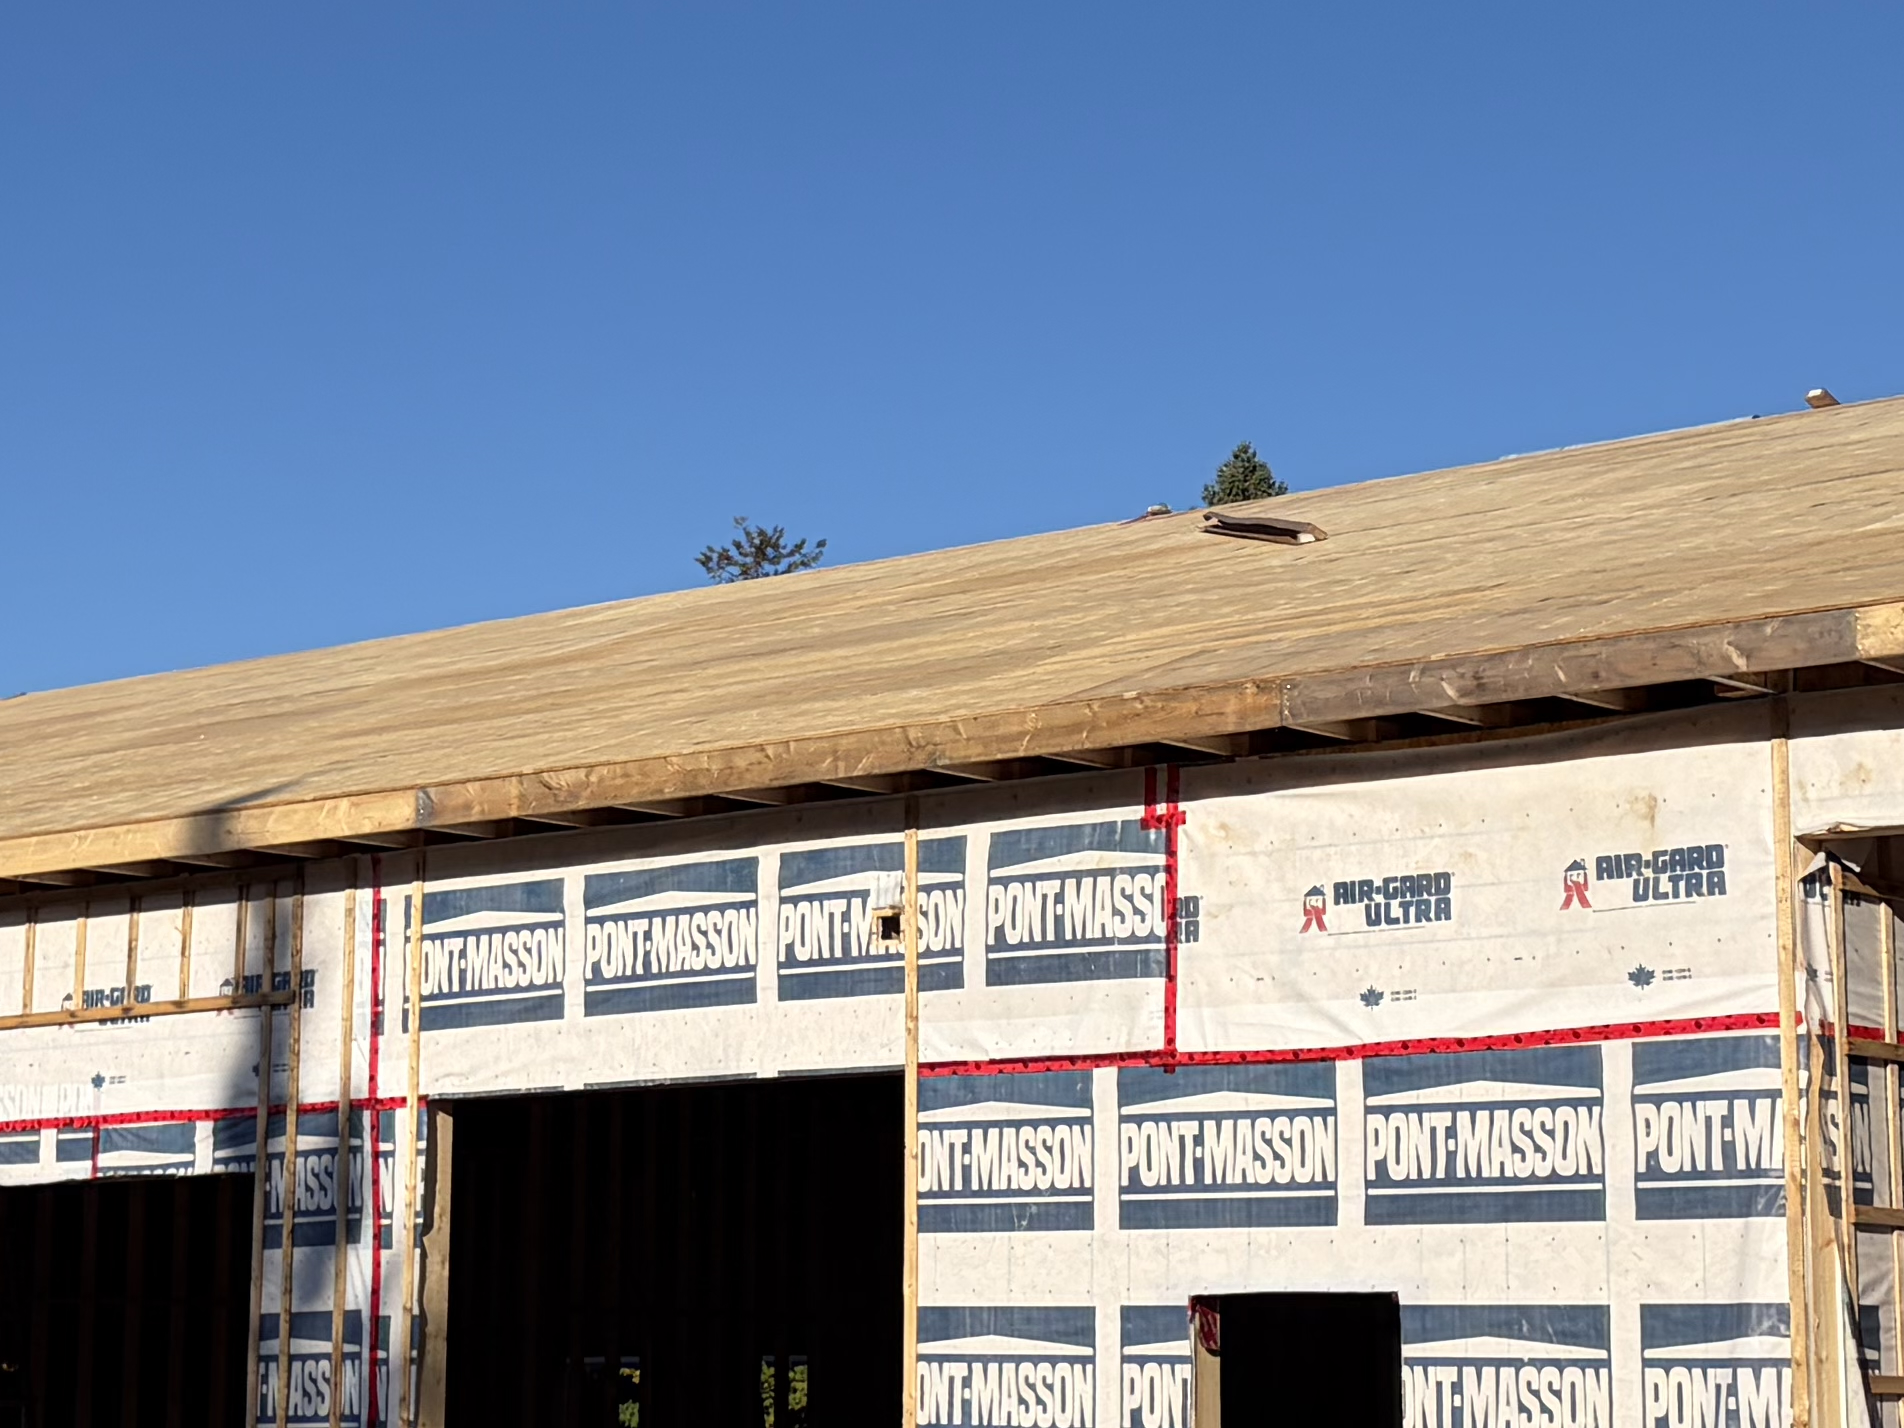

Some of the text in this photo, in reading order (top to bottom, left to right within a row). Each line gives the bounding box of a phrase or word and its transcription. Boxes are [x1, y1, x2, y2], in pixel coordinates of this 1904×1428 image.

[1332, 872, 1453, 907] AIR-GARD
[1596, 844, 1725, 880] AIR-GARD
[1633, 871, 1727, 902] ULTRA
[585, 906, 758, 980] PONT-MASSON
[1365, 900, 1452, 928] ULTRA
[421, 926, 563, 996] ONT-MASSON
[918, 1122, 1092, 1193] ONT-MASSON
[1119, 1116, 1336, 1188] PONT-MASSON
[1365, 1104, 1602, 1184] PONT-MASSON
[917, 1361, 1094, 1428] ONT-MASSON
